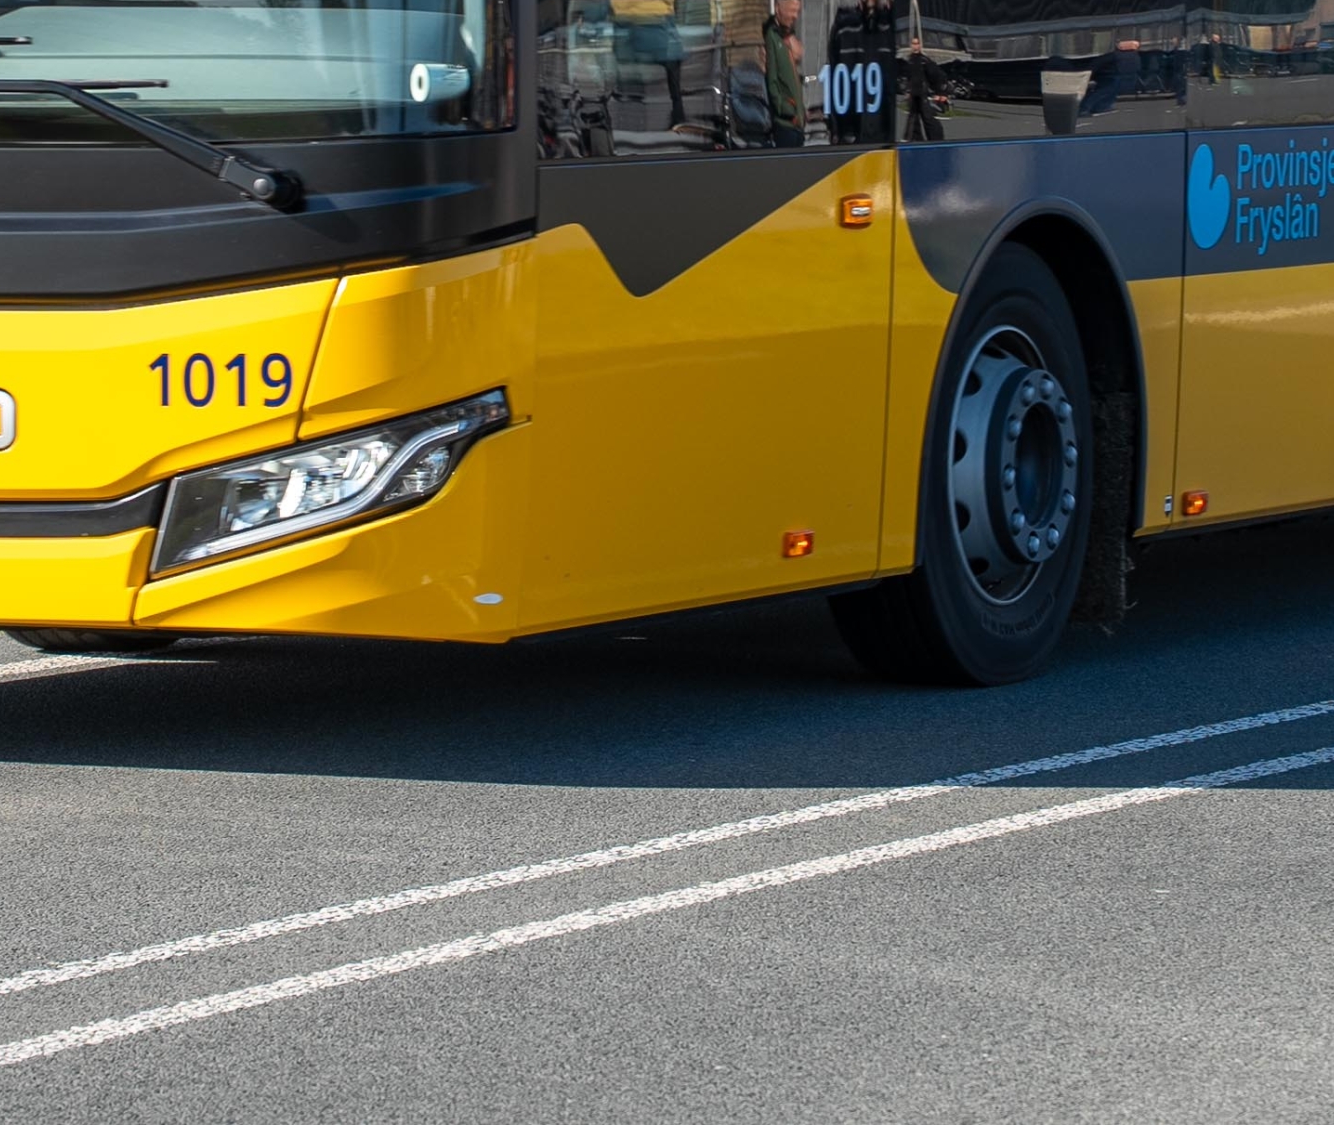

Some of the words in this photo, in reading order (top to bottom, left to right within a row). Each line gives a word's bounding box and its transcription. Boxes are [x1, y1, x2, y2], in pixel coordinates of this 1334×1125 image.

[817, 61, 884, 116] 1019
[1235, 193, 1319, 255] Fryslân
[148, 352, 293, 408] 1019
